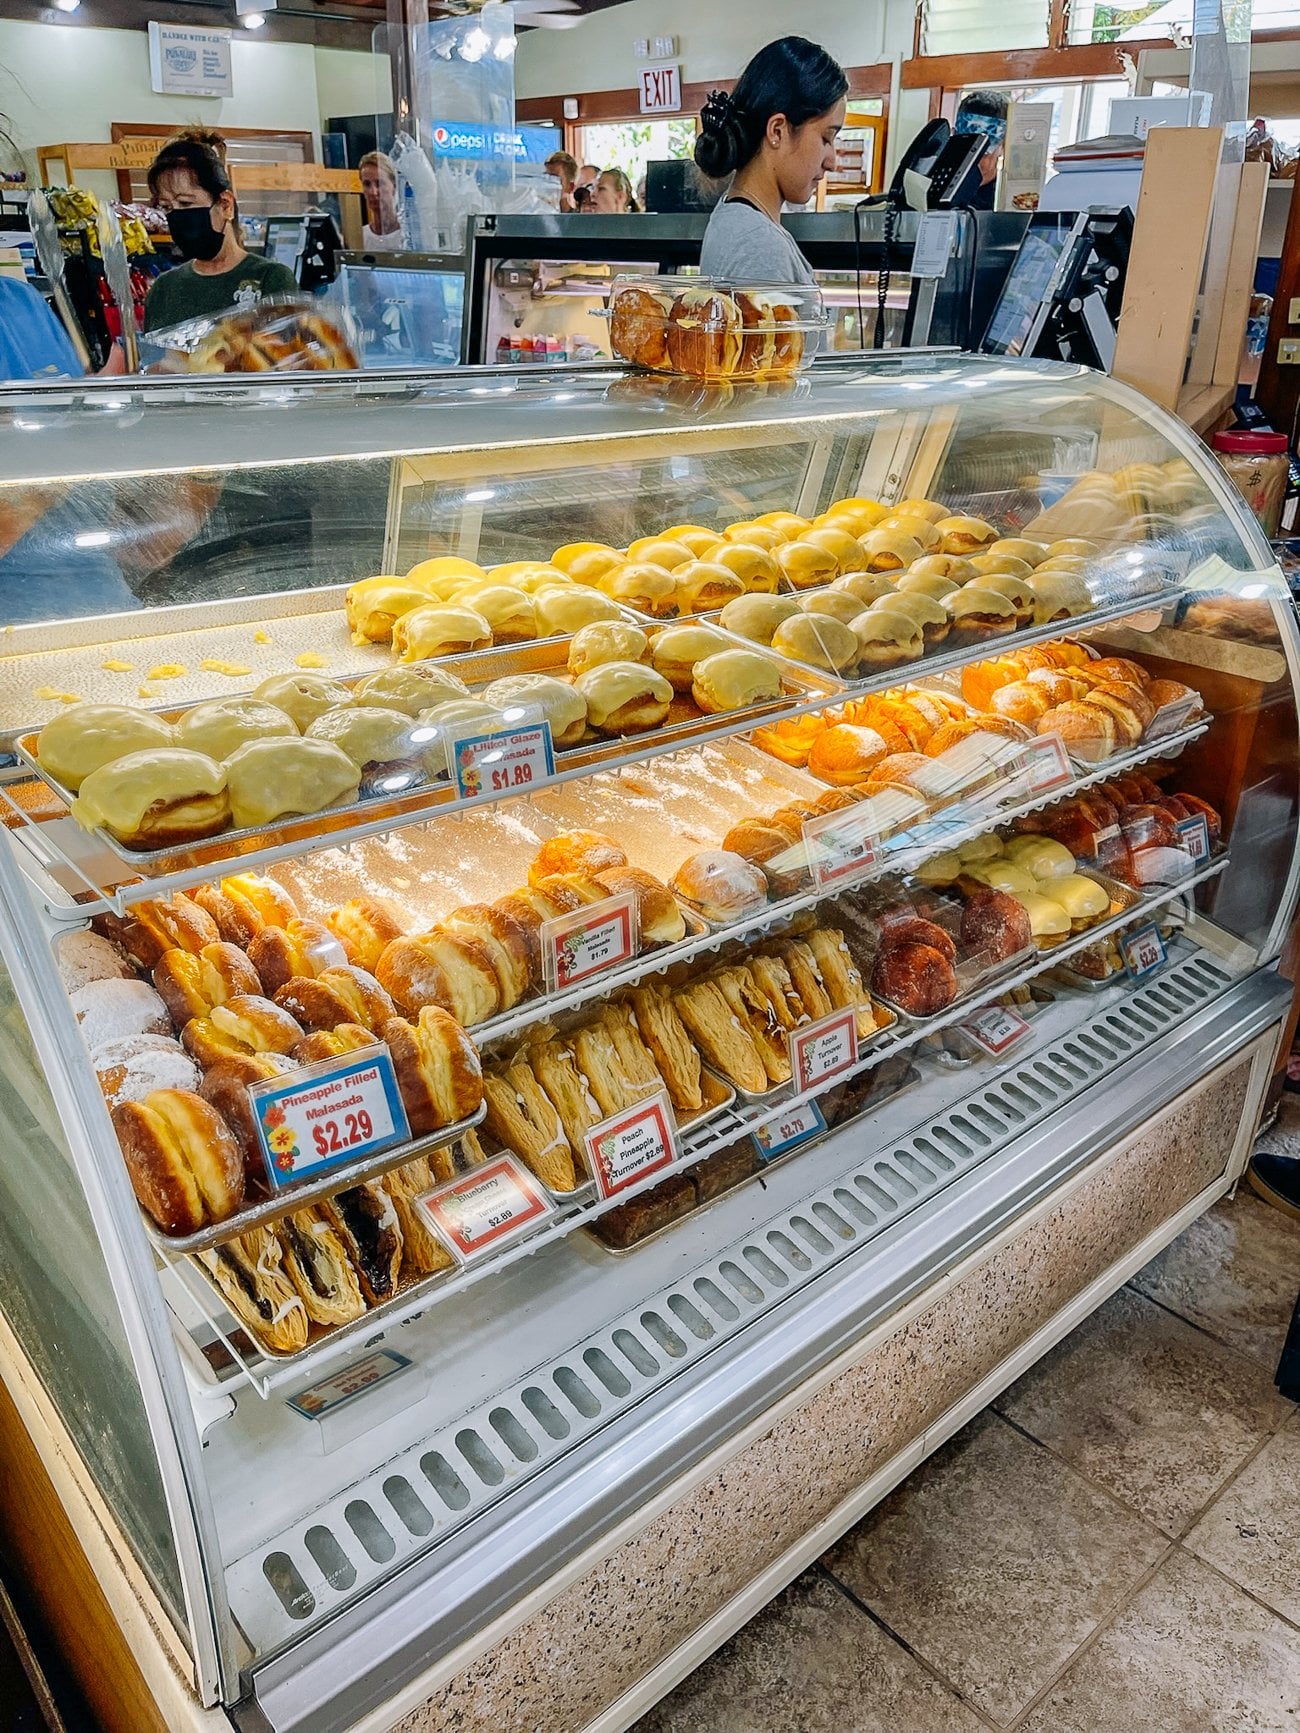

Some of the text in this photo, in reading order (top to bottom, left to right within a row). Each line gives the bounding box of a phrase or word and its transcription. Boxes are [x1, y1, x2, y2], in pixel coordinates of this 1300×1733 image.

[643, 69, 673, 107] EXIT
[450, 133, 485, 150] pepsi
[494, 144, 527, 157] ALOHA
[1246, 469, 1262, 487] $
[510, 732, 541, 745] Glaze
[491, 763, 532, 791] $1.89
[582, 925, 616, 946] Vanilla Filled
[587, 938, 611, 952] Malasada
[821, 1034, 838, 1048] Apple
[817, 1043, 843, 1060] Turnover
[281, 1069, 378, 1110] Pineapple Filled
[305, 1094, 364, 1121] Malasada
[312, 1110, 373, 1159] $2.29
[621, 1127, 644, 1145] Peach
[779, 1118, 805, 1139] $2.79
[619, 1137, 655, 1161] Pineapple
[614, 1155, 645, 1178] Turnover
[457, 1178, 499, 1203] Blueberry
[479, 1200, 508, 1218] Turnover
[488, 1209, 513, 1229] $2.89
